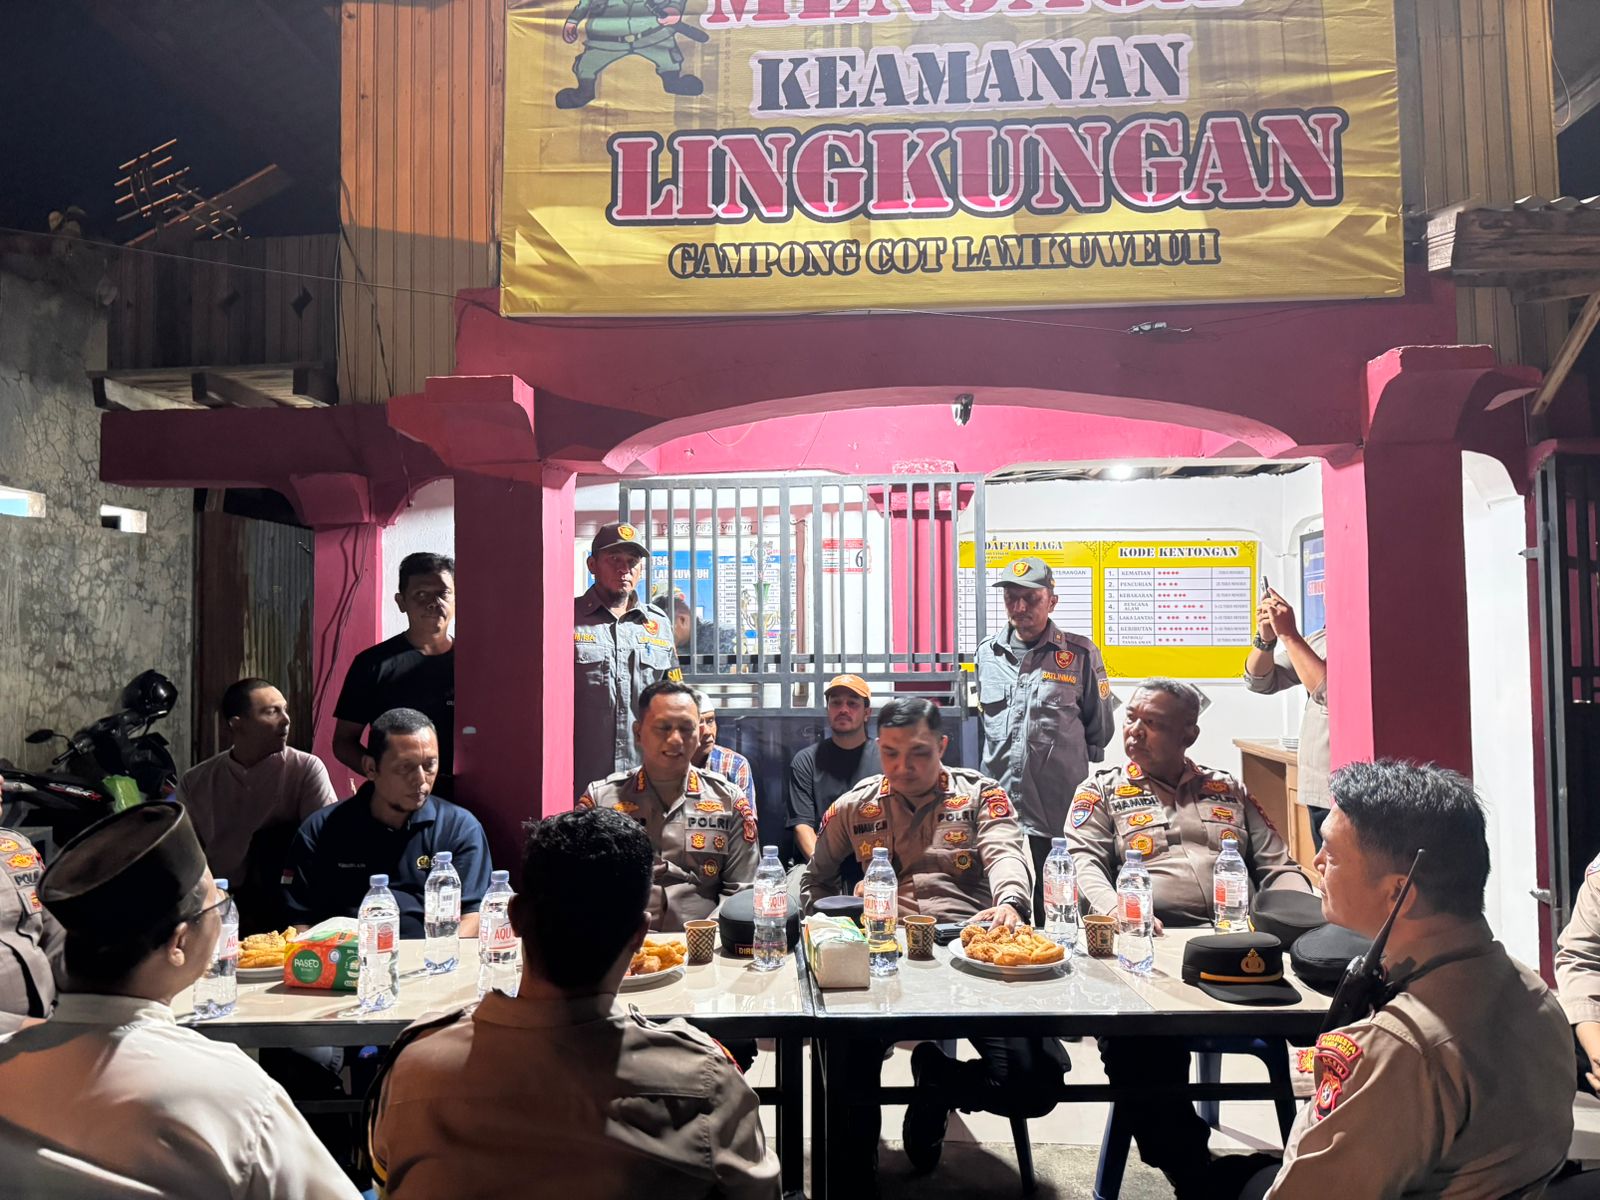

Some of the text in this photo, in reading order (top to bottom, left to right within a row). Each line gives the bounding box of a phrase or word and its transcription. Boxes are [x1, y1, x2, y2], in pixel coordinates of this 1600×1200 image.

[755, 40, 1187, 112] KEAMANAN
[609, 111, 1345, 223] LINGKUNGAN
[668, 229, 1221, 278] GAMPONG COT LAMKUWEUH
[984, 541, 1063, 551] DAFTAR JAGA
[1119, 546, 1238, 558] KODE KENTONGAN
[654, 568, 709, 579] LAMKUWUH
[687, 816, 730, 829] POLRI
[937, 809, 975, 823] POLRI
[293, 957, 320, 969] PASEO
